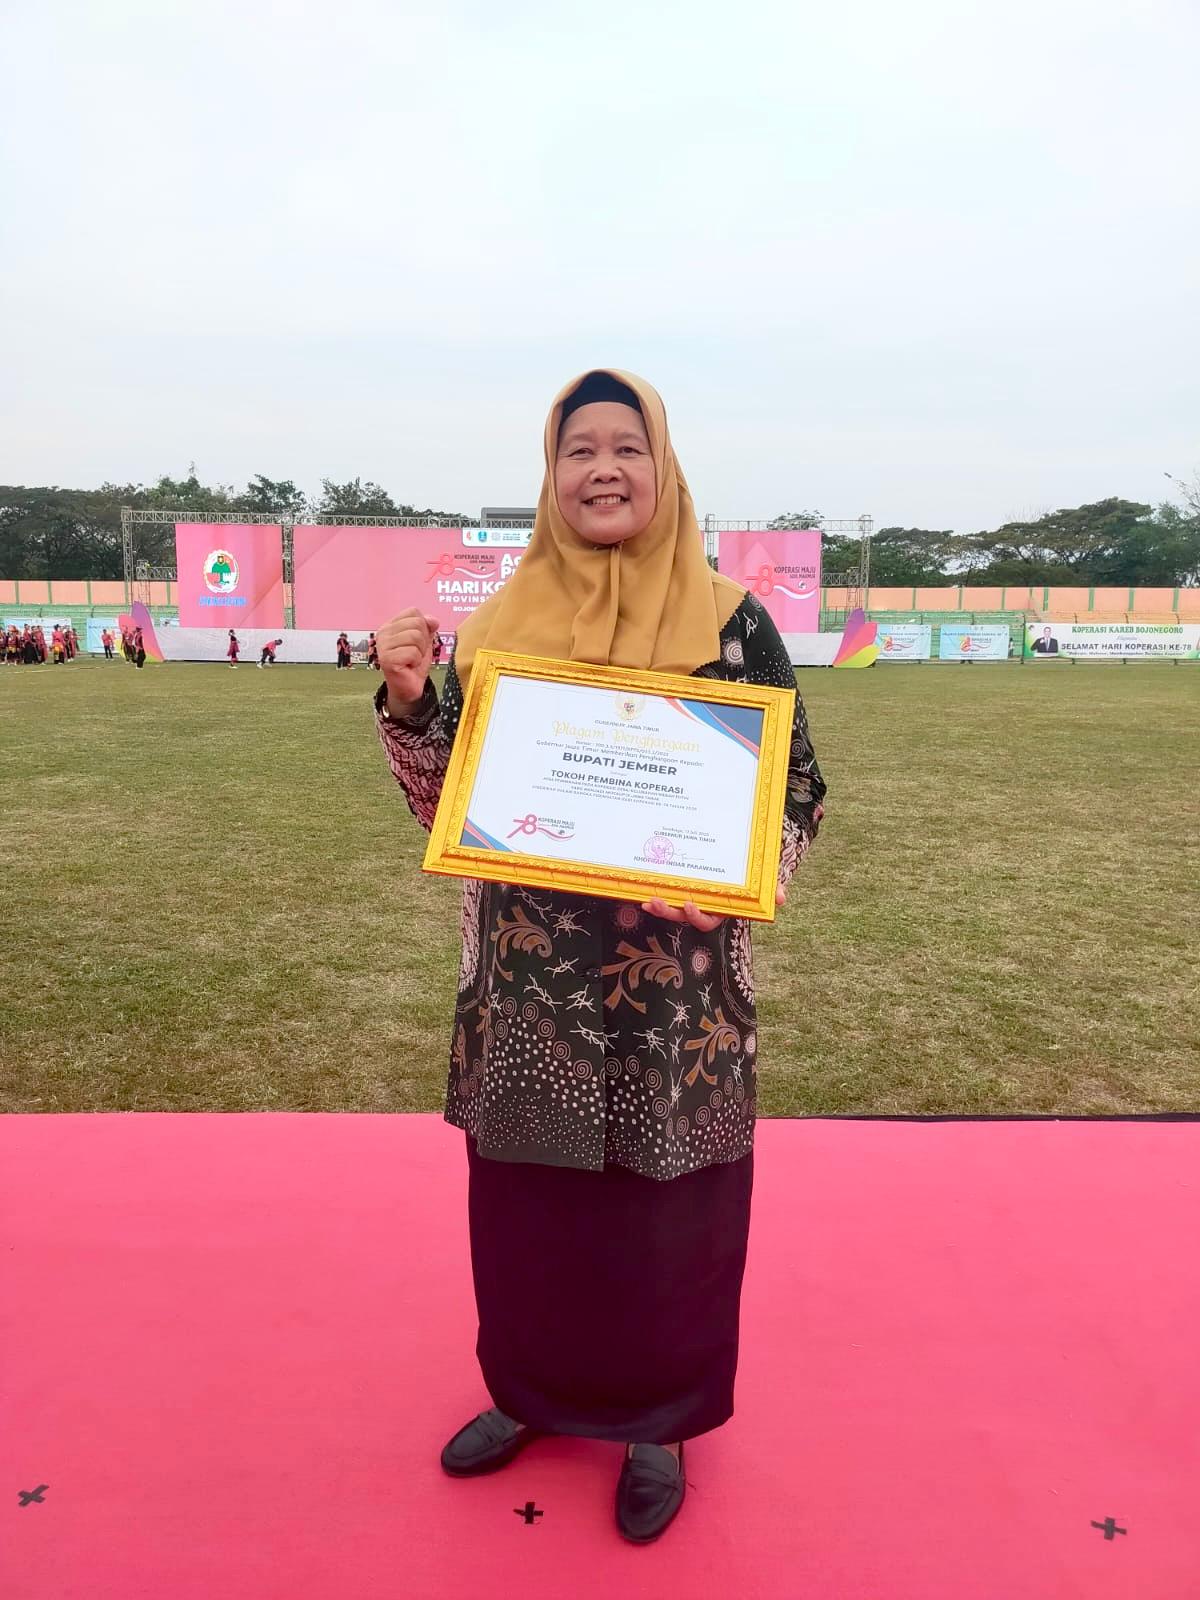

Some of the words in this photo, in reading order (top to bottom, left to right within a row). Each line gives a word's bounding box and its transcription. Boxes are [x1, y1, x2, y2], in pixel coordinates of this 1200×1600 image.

[774, 566, 800, 574] KOPERASI
[801, 566, 816, 574] MAJU
[437, 580, 479, 594] HARI
[1071, 626, 1107, 634] KOPERASI
[1136, 626, 1184, 634] BOJONEGORO
[1125, 643, 1167, 651] KOPERASI
[562, 752, 615, 767] BUPATI
[618, 759, 677, 776] JEMBER
[551, 769, 585, 781] TOKOH
[587, 774, 632, 788] PEMBINA
[634, 781, 684, 795] KOPERASI
